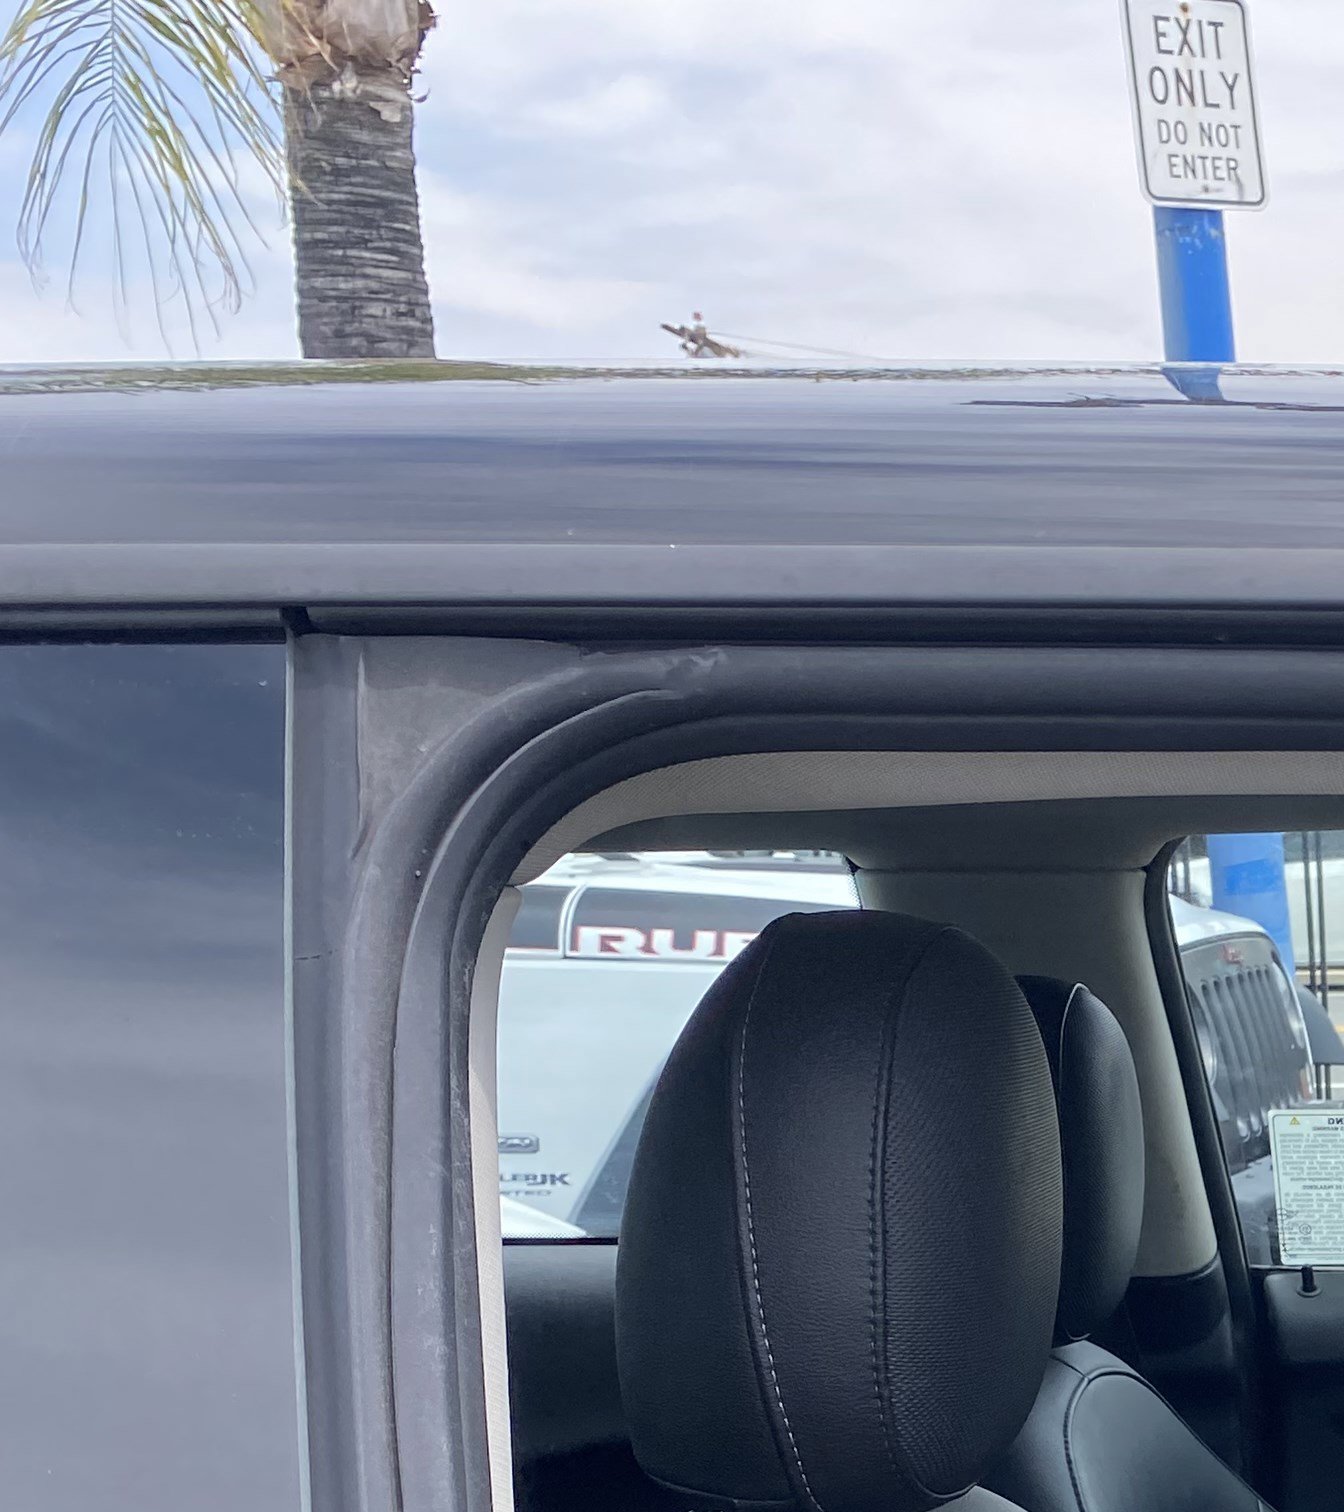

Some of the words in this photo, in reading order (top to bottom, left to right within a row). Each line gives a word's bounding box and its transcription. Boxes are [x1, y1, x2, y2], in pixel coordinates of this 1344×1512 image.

[1152, 15, 1224, 60] EXIT
[1149, 65, 1239, 110] ONLY
[1157, 118, 1188, 145] DO
[1199, 121, 1242, 149] NOT
[1167, 153, 1239, 182] ENTER
